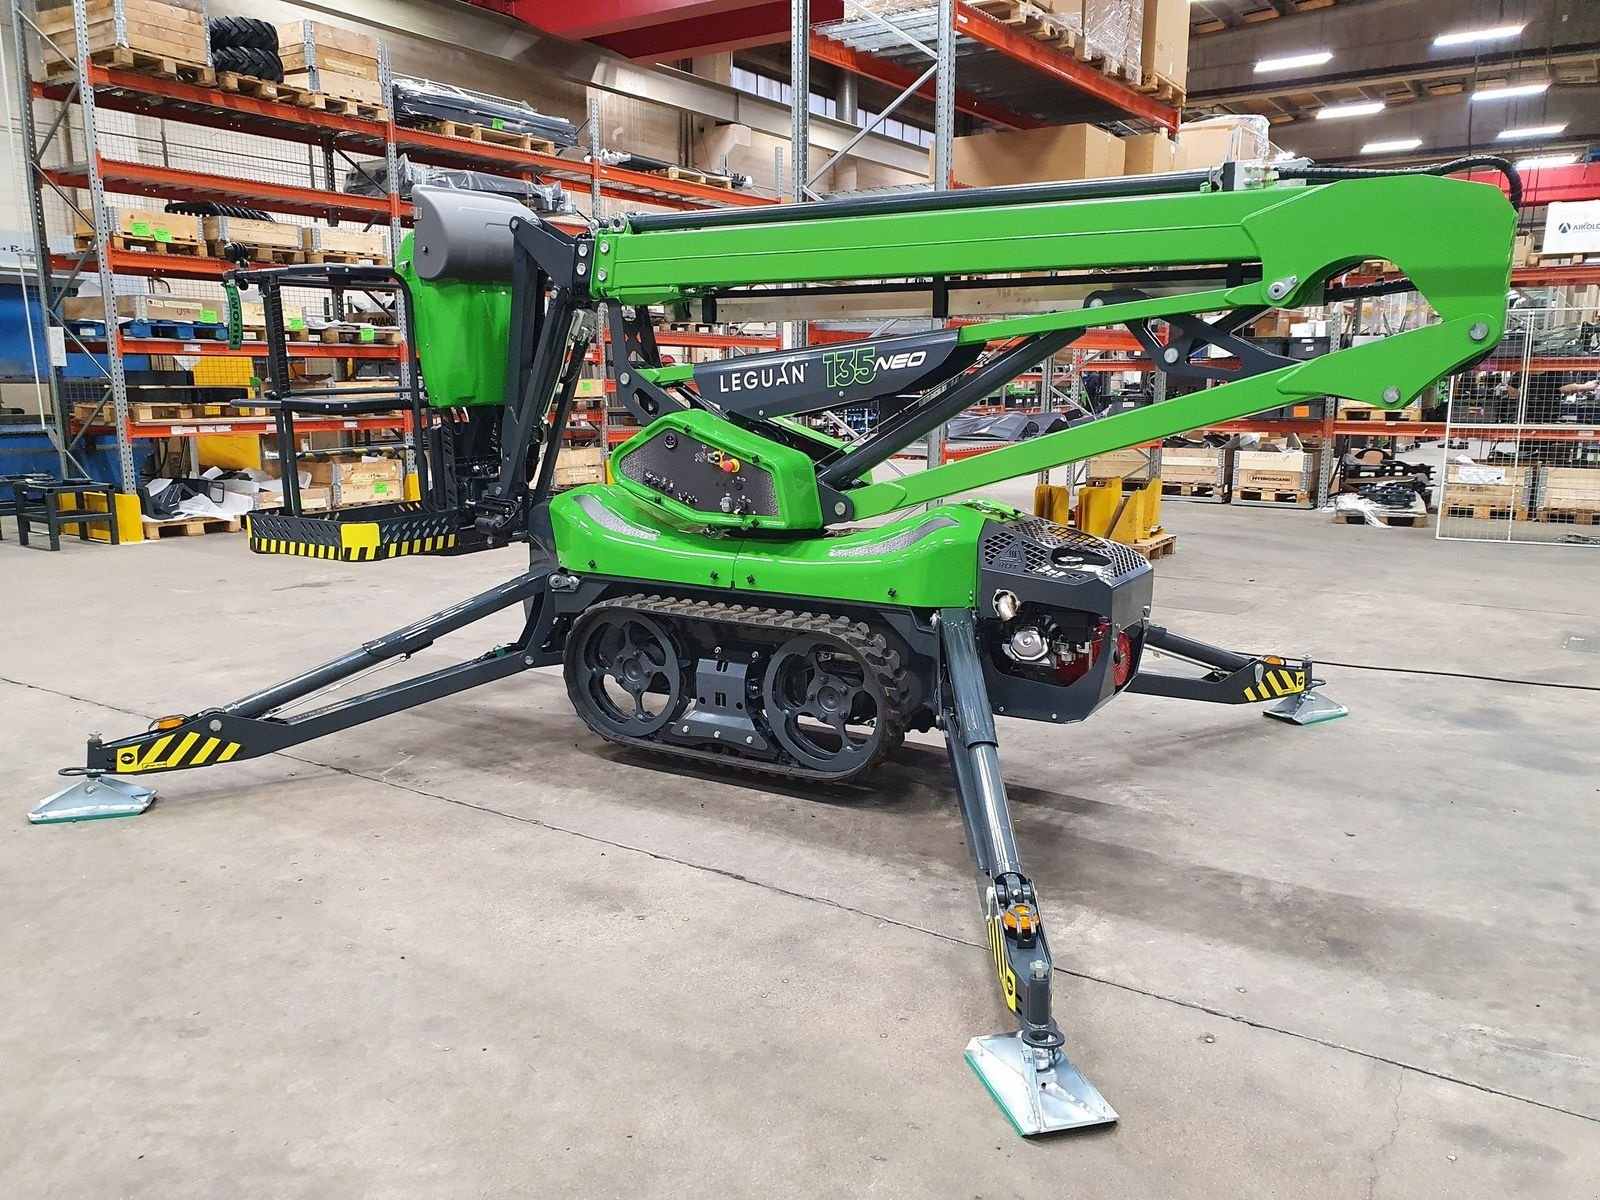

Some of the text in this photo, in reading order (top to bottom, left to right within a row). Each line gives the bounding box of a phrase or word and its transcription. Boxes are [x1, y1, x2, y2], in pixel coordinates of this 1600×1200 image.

[719, 346, 926, 393] LEGUAN 135 NEO
